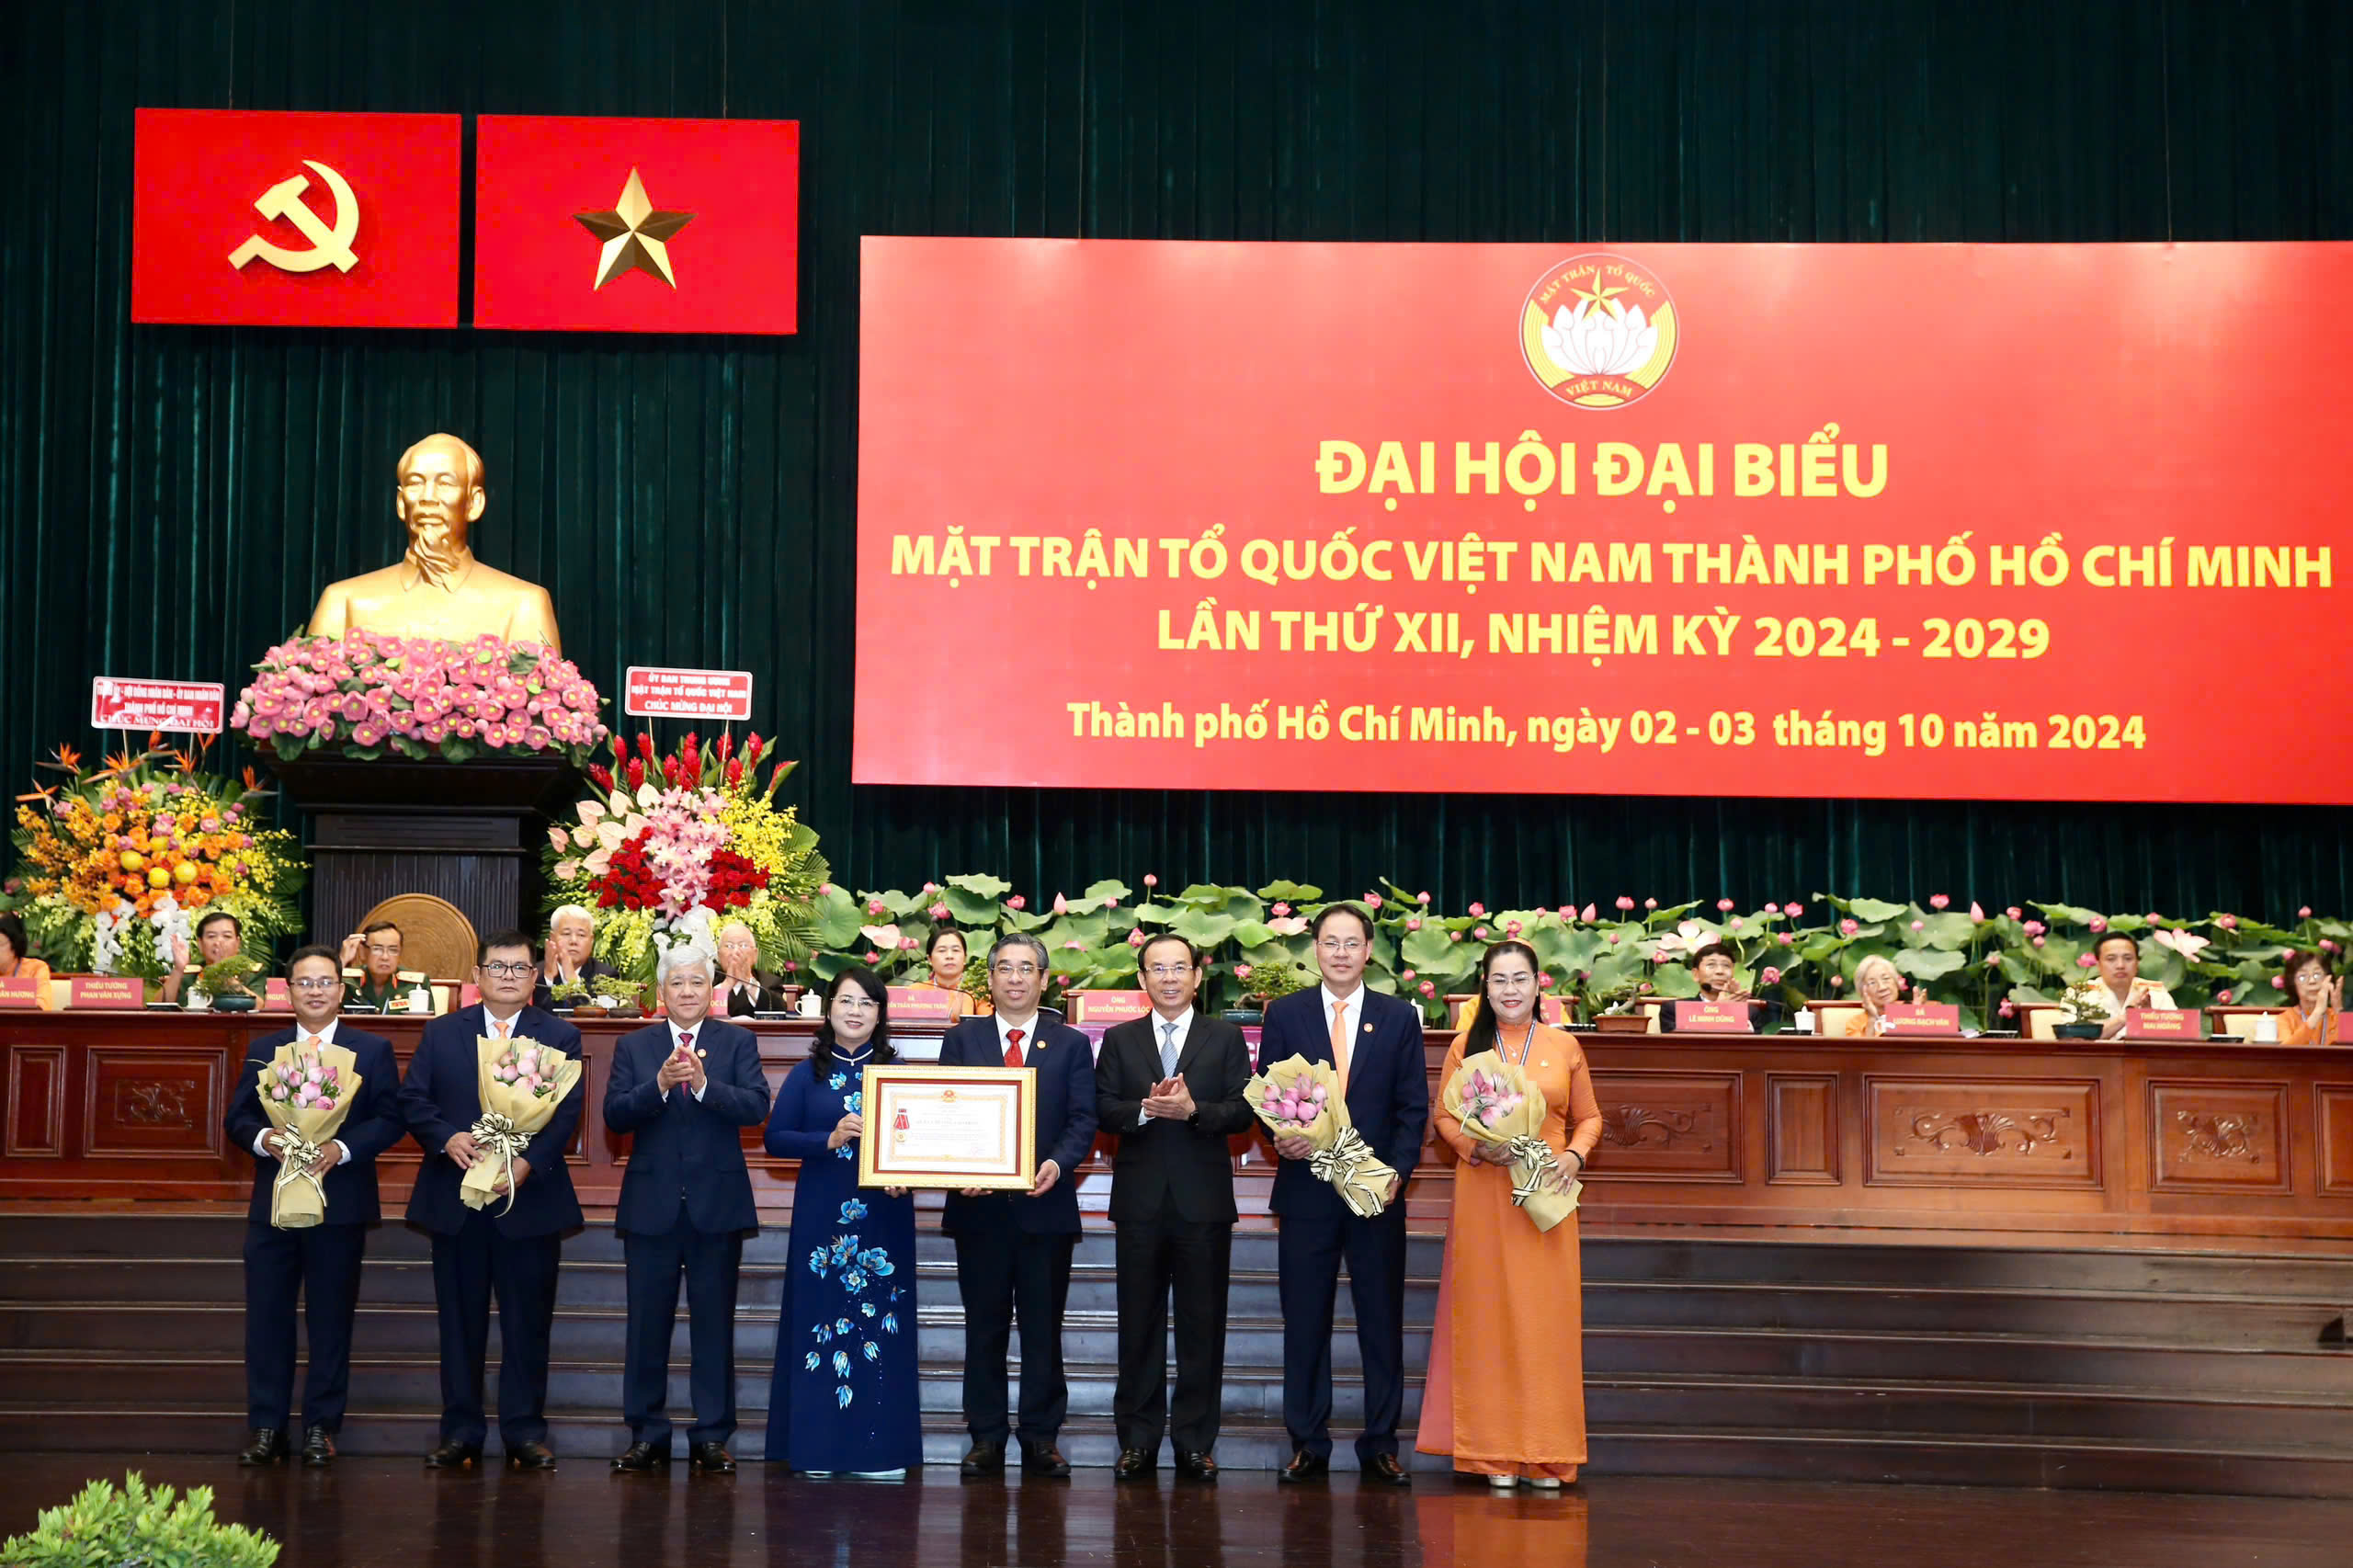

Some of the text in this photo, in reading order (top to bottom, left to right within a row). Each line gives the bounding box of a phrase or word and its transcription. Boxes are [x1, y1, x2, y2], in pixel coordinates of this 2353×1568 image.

[1624, 270, 1656, 299] QUỐC
[1565, 378, 1633, 398] VIỆT NAM
[1314, 422, 1888, 514] ĐẠI HỘI ĐẠI BIỂU
[891, 523, 2332, 595] MẶT TRẬN TỔ QUỐC VIỆT NAM THÀNH PHỐ HỒ CHÍ MINH
[1158, 597, 2050, 667] LẦN THỨ XII, NHIỆM KỲ 2024 - 2029
[1066, 698, 2146, 756] Thành phố Hồ Chí Minh, ngày 02 - 03 tháng 10 năm 2024
